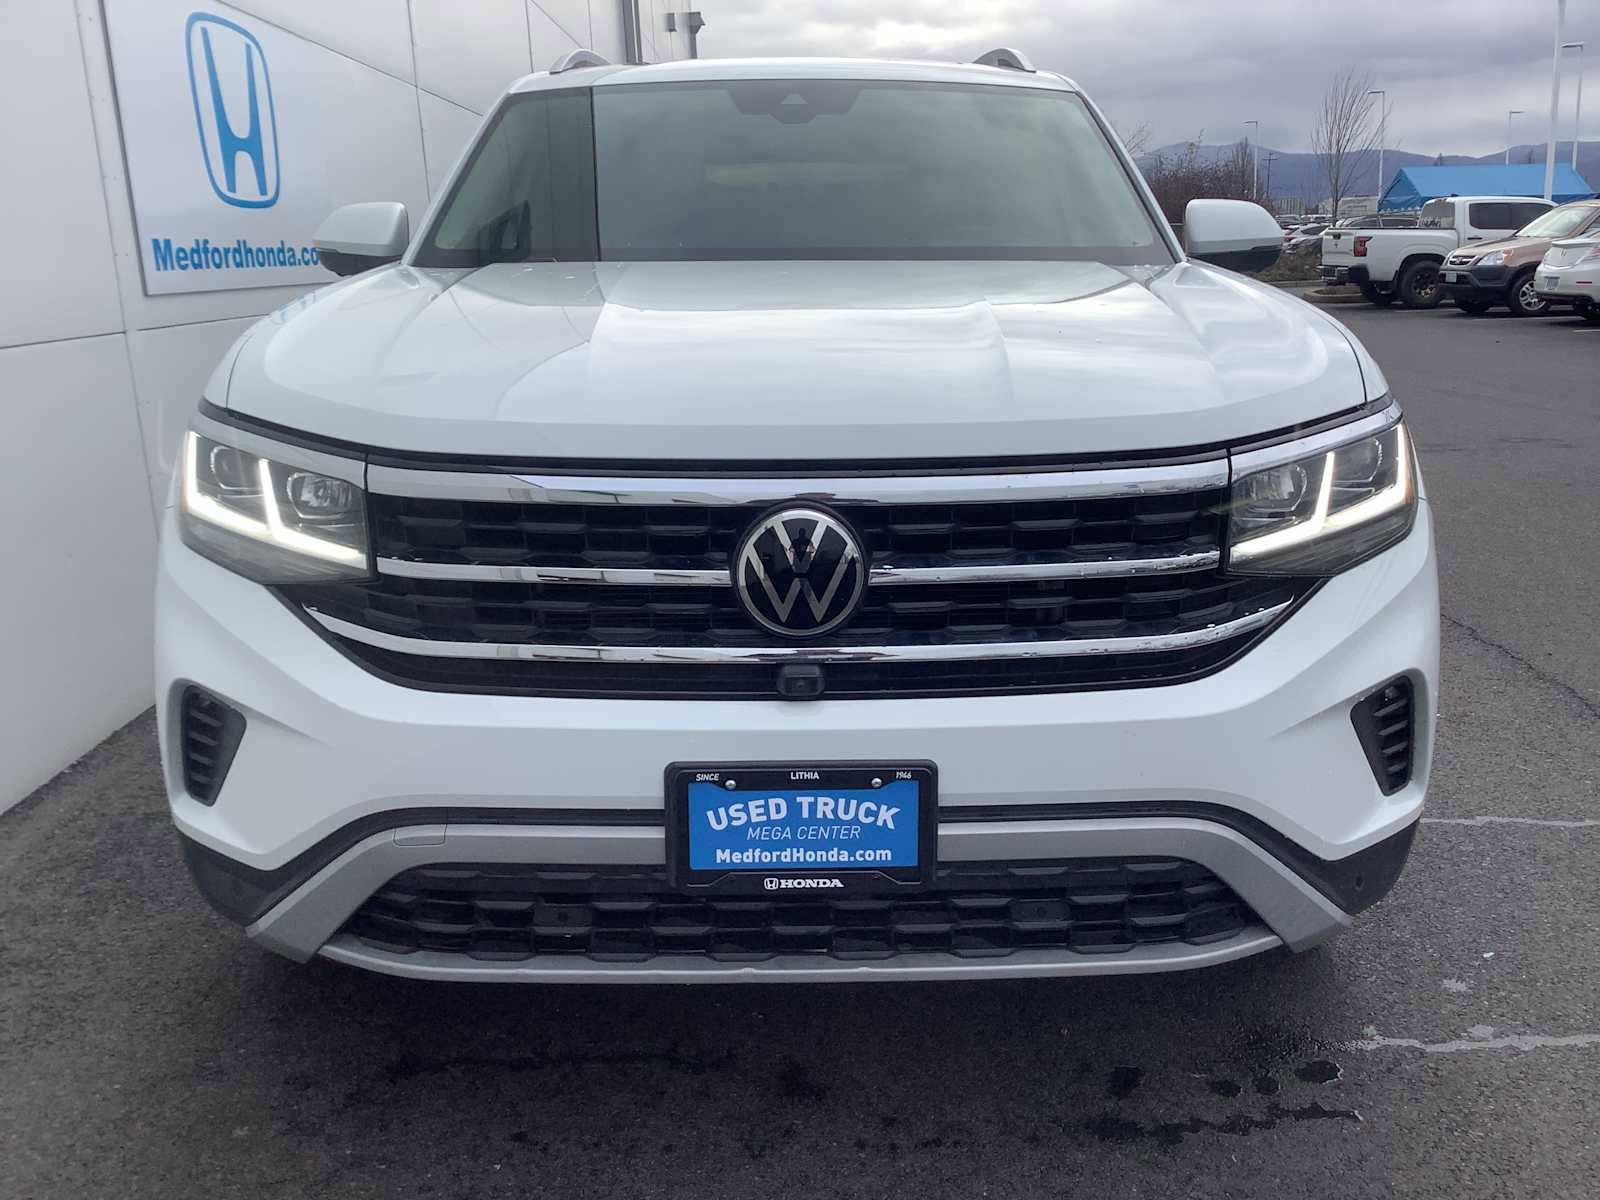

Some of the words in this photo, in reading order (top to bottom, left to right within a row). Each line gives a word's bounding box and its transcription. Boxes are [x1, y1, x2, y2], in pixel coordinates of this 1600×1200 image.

[151, 238, 321, 272] Medfordhonda.co
[696, 773, 720, 781] SINCE
[790, 771, 820, 780] LITHIA
[706, 797, 787, 831] USED
[796, 796, 901, 830] TRUCK
[746, 826, 793, 841] MEGA
[796, 825, 861, 840] CENTER
[715, 848, 892, 864] MedfordHonda.com
[779, 878, 844, 889] HONDA
